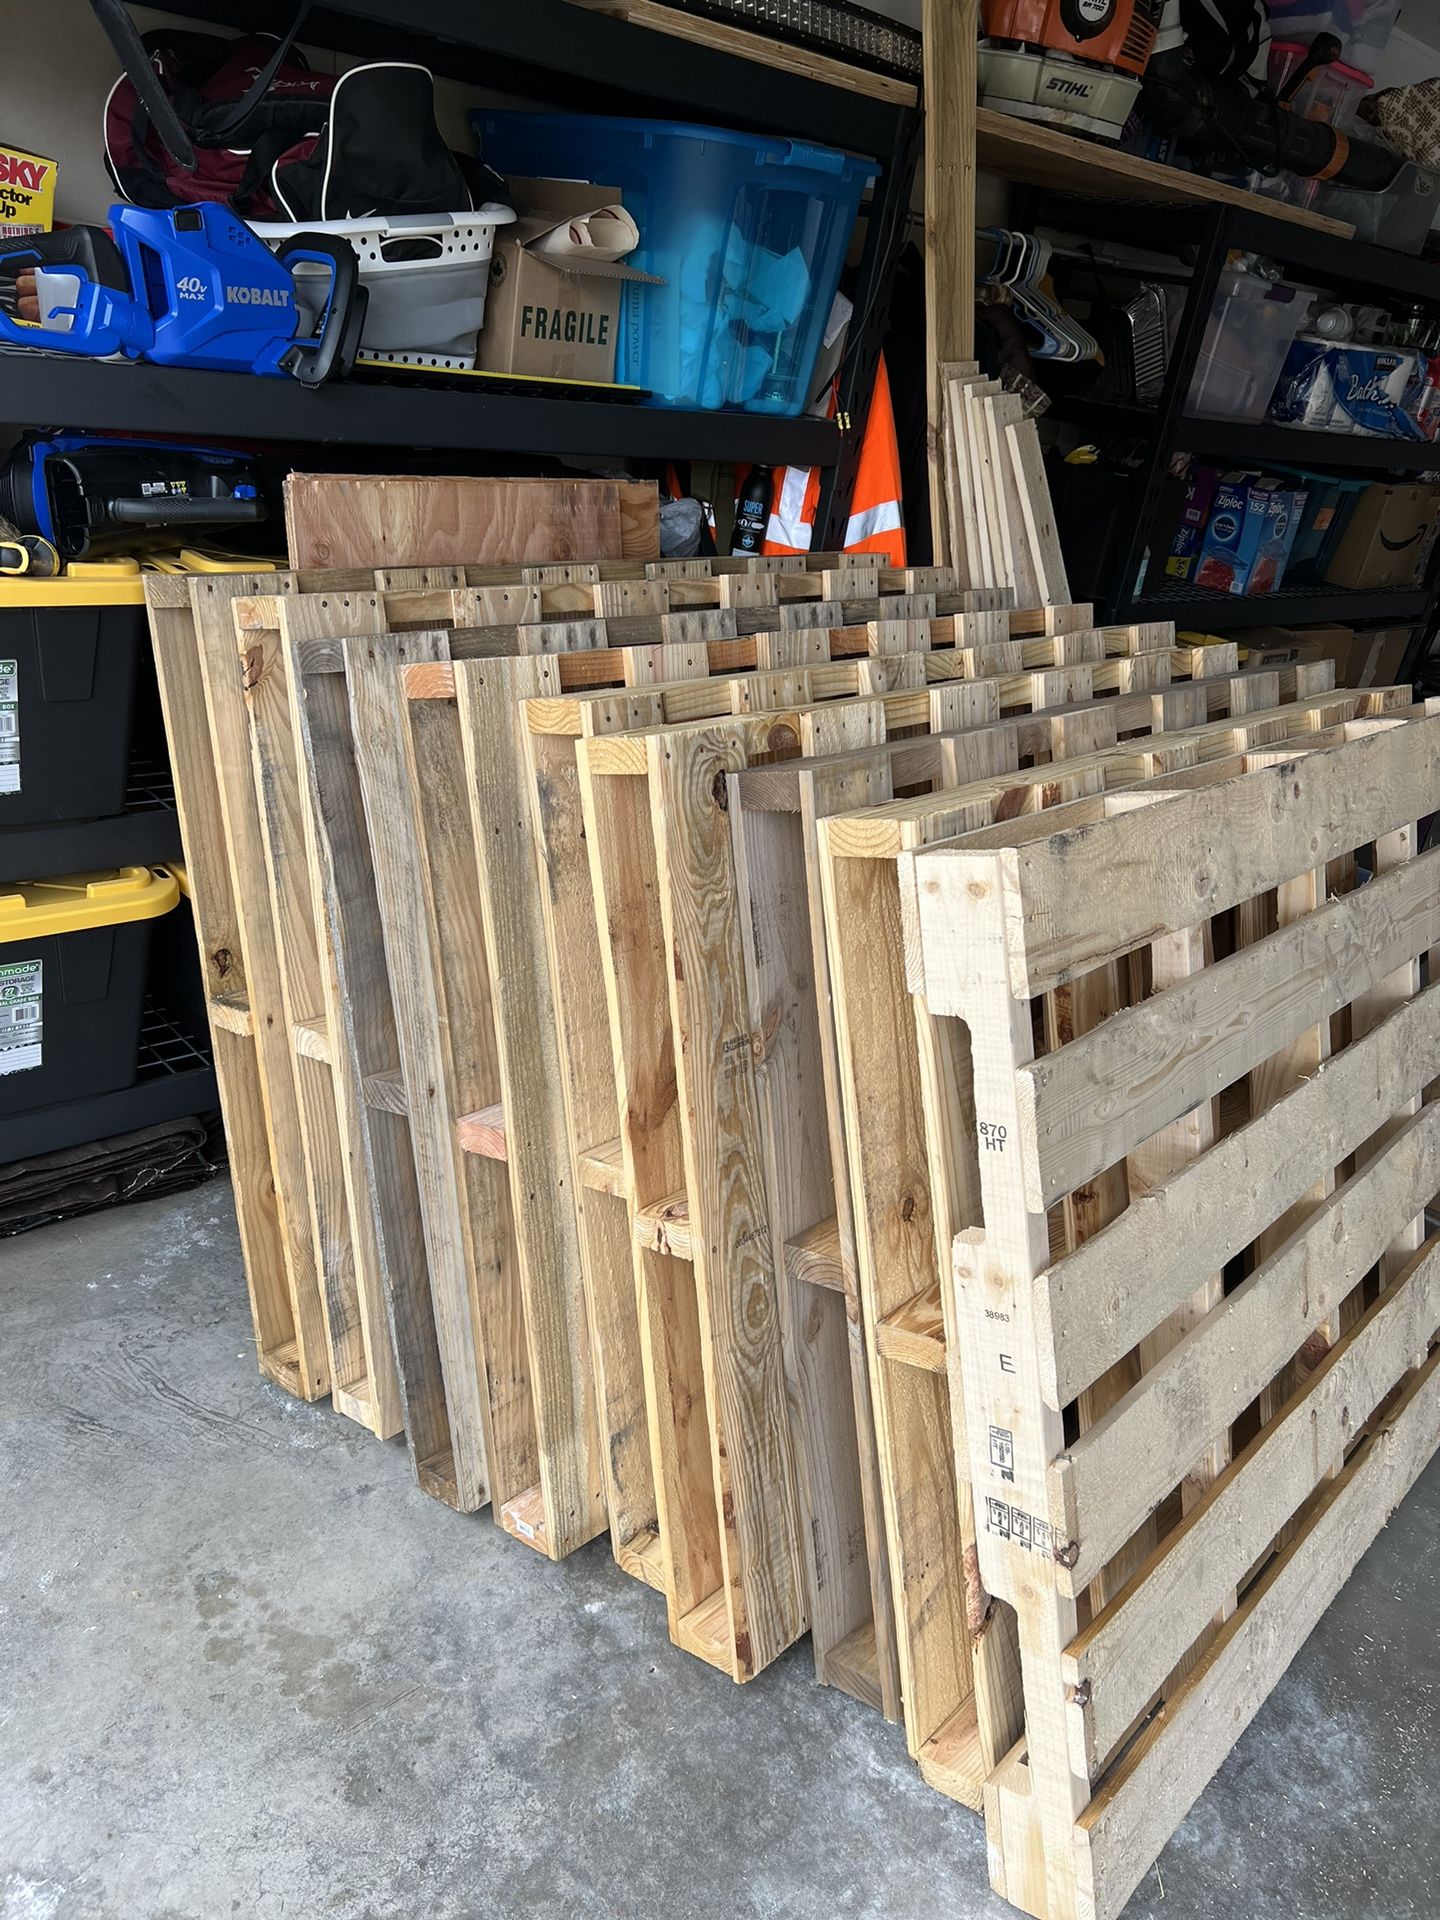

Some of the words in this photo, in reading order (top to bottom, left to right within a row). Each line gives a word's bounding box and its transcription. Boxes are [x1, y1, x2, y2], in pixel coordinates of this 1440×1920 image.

[1046, 77, 1089, 98] STIHL
[180, 292, 205, 301] MAX
[226, 286, 289, 307] KOBALT
[520, 305, 610, 346] FRAGILE
[1347, 374, 1380, 401] Bath
[743, 499, 764, 515] SUPER
[1218, 495, 1244, 510] Ziploc
[1250, 501, 1266, 513] 152
[5, 987, 15, 996] 27
[979, 1122, 1007, 1139] 870
[985, 1136, 1006, 1152] HT
[984, 1308, 1010, 1323] 38983
[999, 1353, 1016, 1375] E
